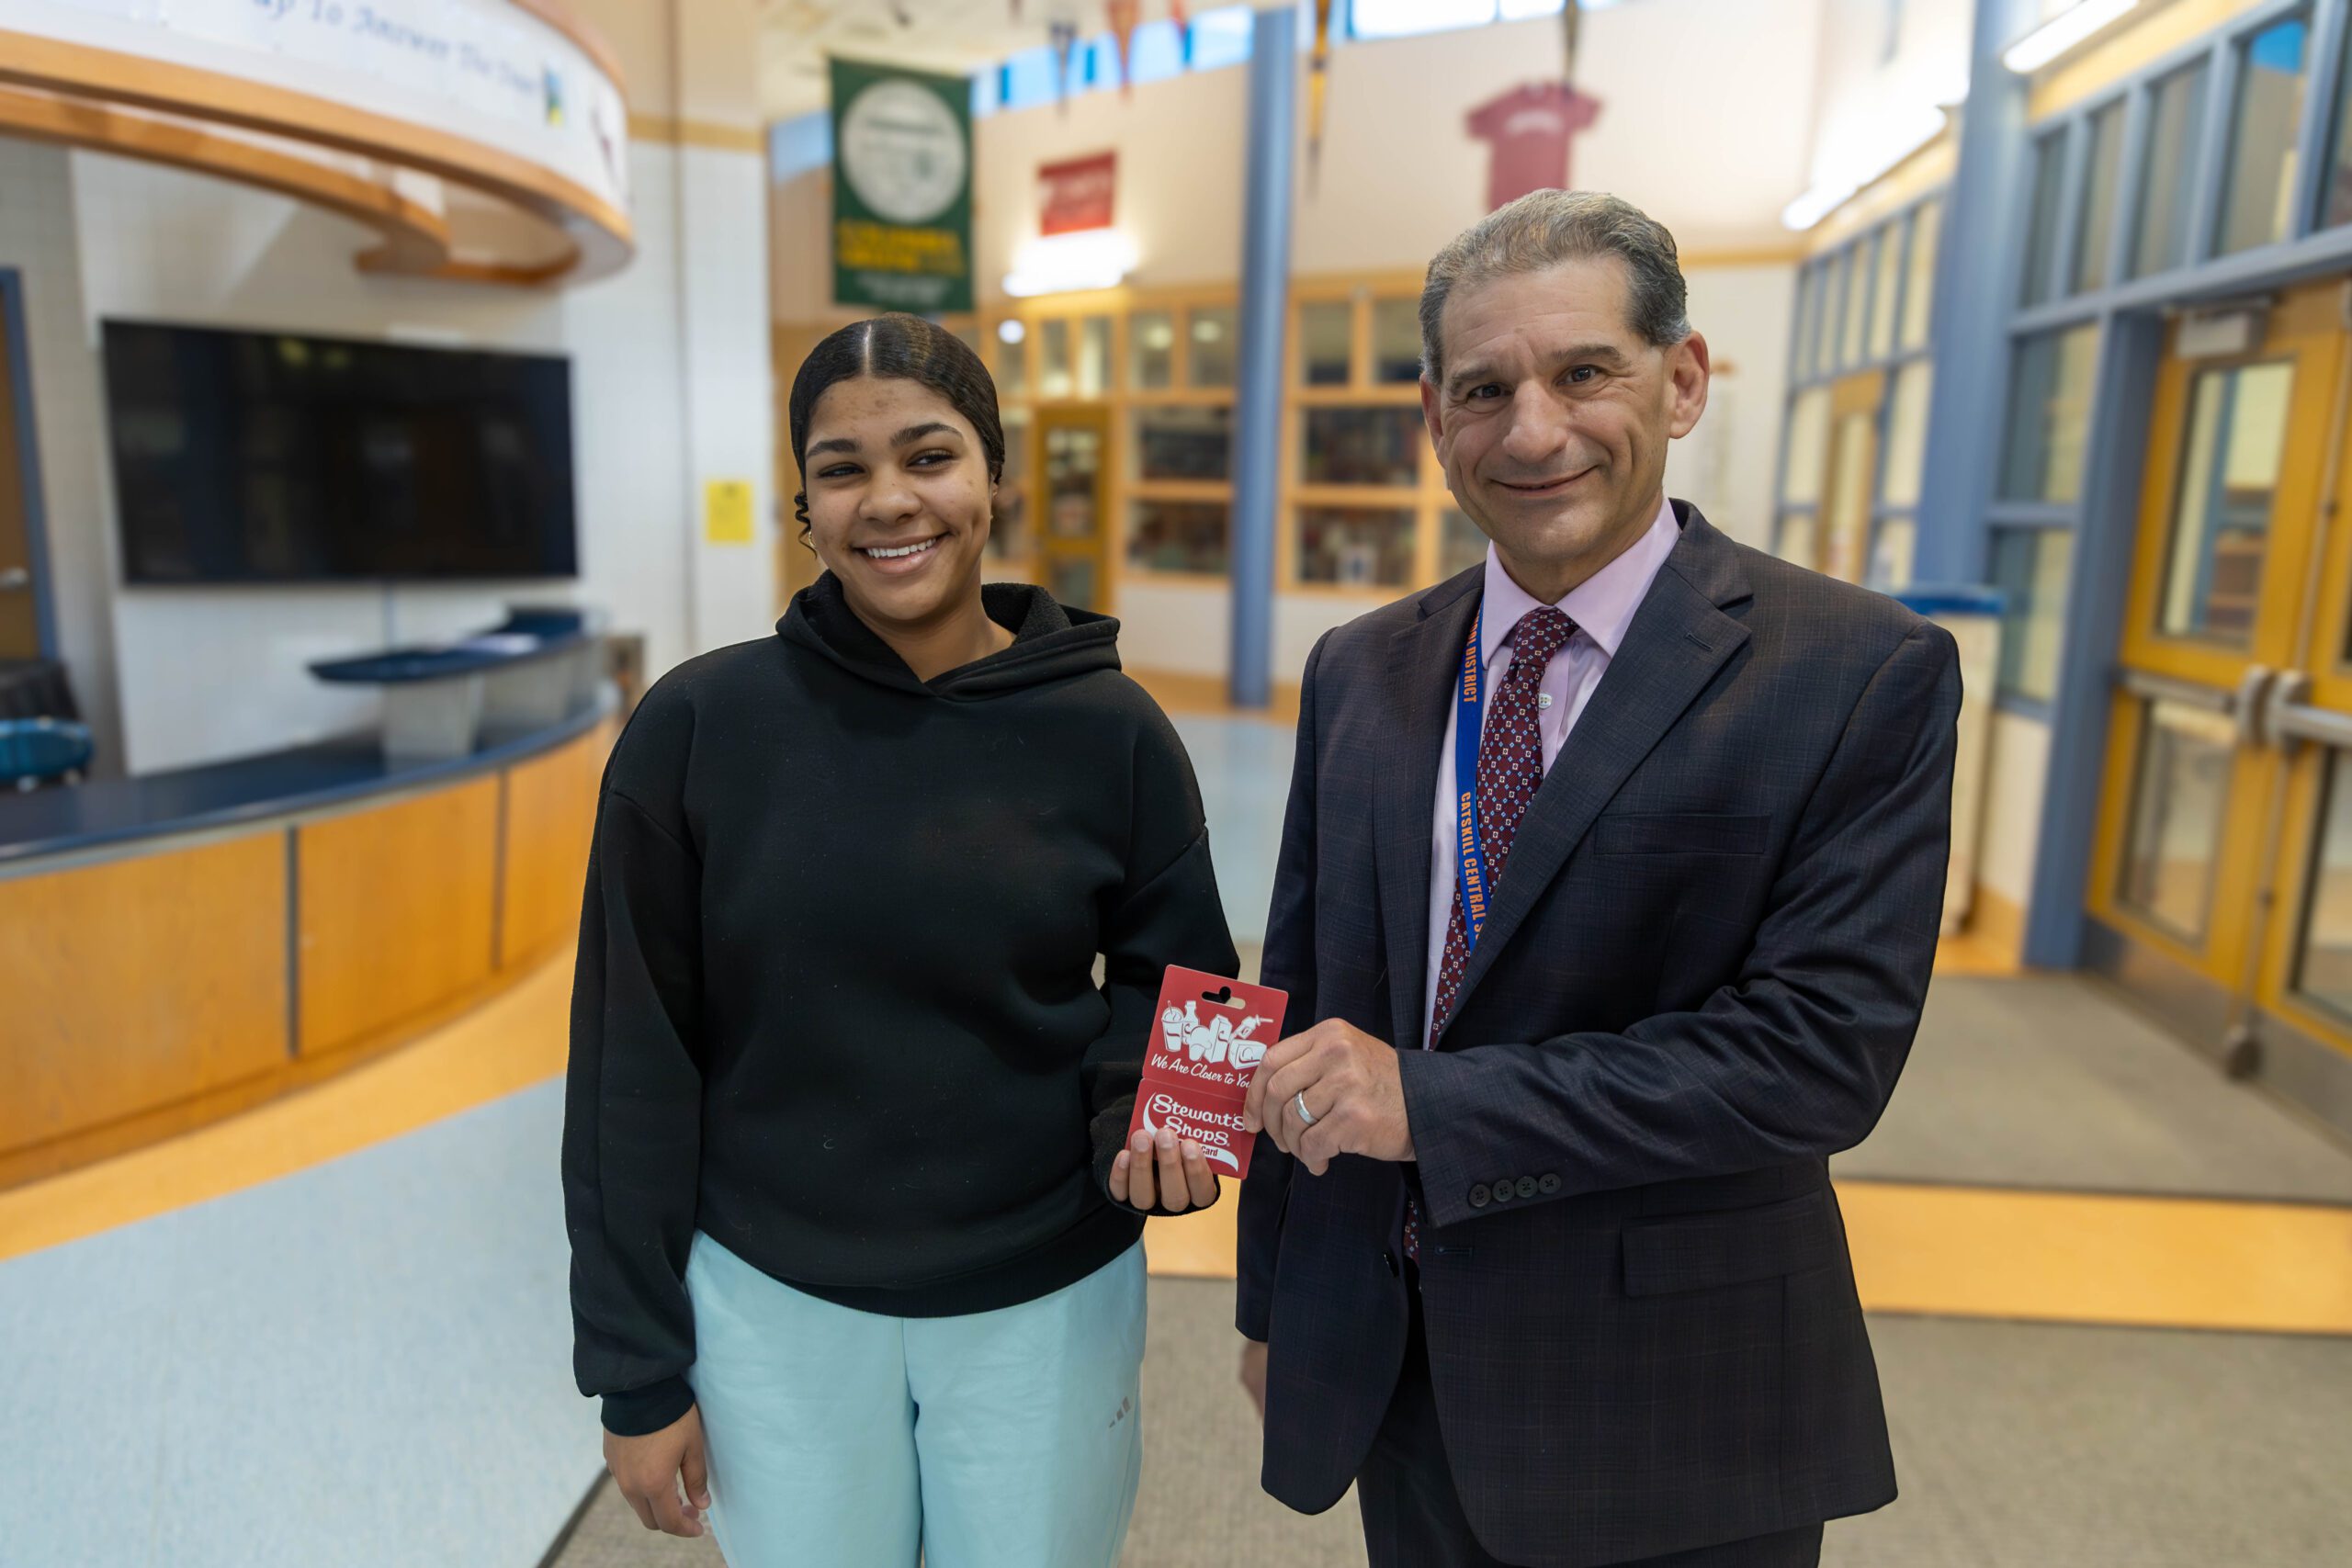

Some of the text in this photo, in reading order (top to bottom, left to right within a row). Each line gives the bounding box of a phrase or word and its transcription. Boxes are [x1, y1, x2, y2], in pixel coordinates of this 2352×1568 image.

[1464, 646, 1477, 703] DISTRICT
[1461, 791, 1475, 856] CATSKILL
[1464, 859, 1486, 920] CENTRAL
[1151, 1054, 1168, 1068] We
[1169, 1058, 1189, 1074] Are
[1191, 1063, 1223, 1082] Closer
[1224, 1072, 1236, 1085] to
[1164, 1115, 1229, 1145] Shops
